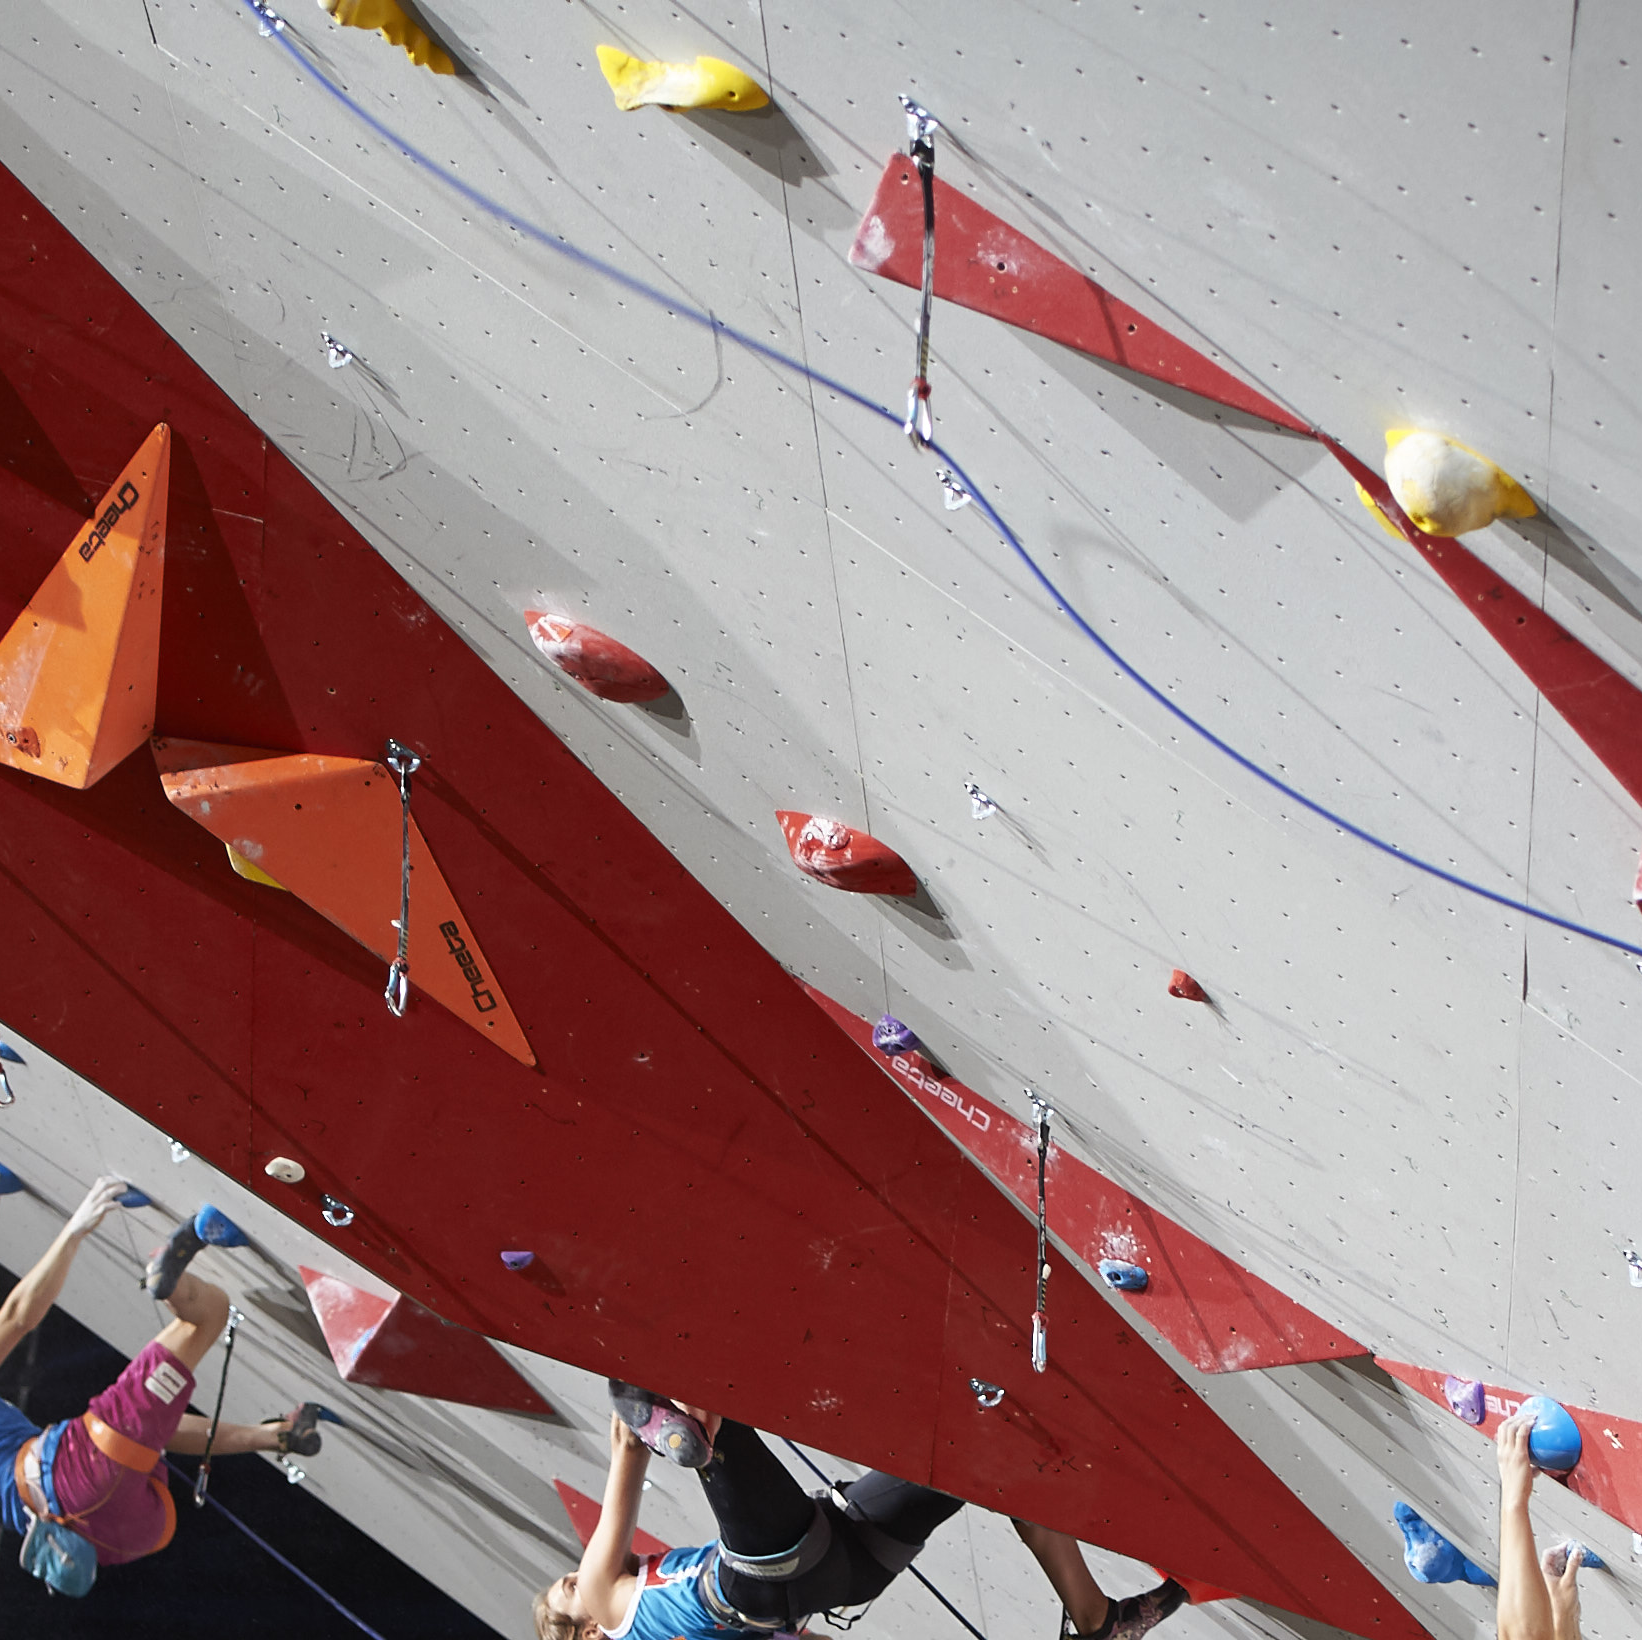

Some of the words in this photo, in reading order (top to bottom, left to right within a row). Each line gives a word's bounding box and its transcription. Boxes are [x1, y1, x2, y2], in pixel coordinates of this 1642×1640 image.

[78, 480, 140, 563] Cheeta
[439, 920, 498, 1013] Cheeta
[891, 1055, 992, 1132] Cheeta
